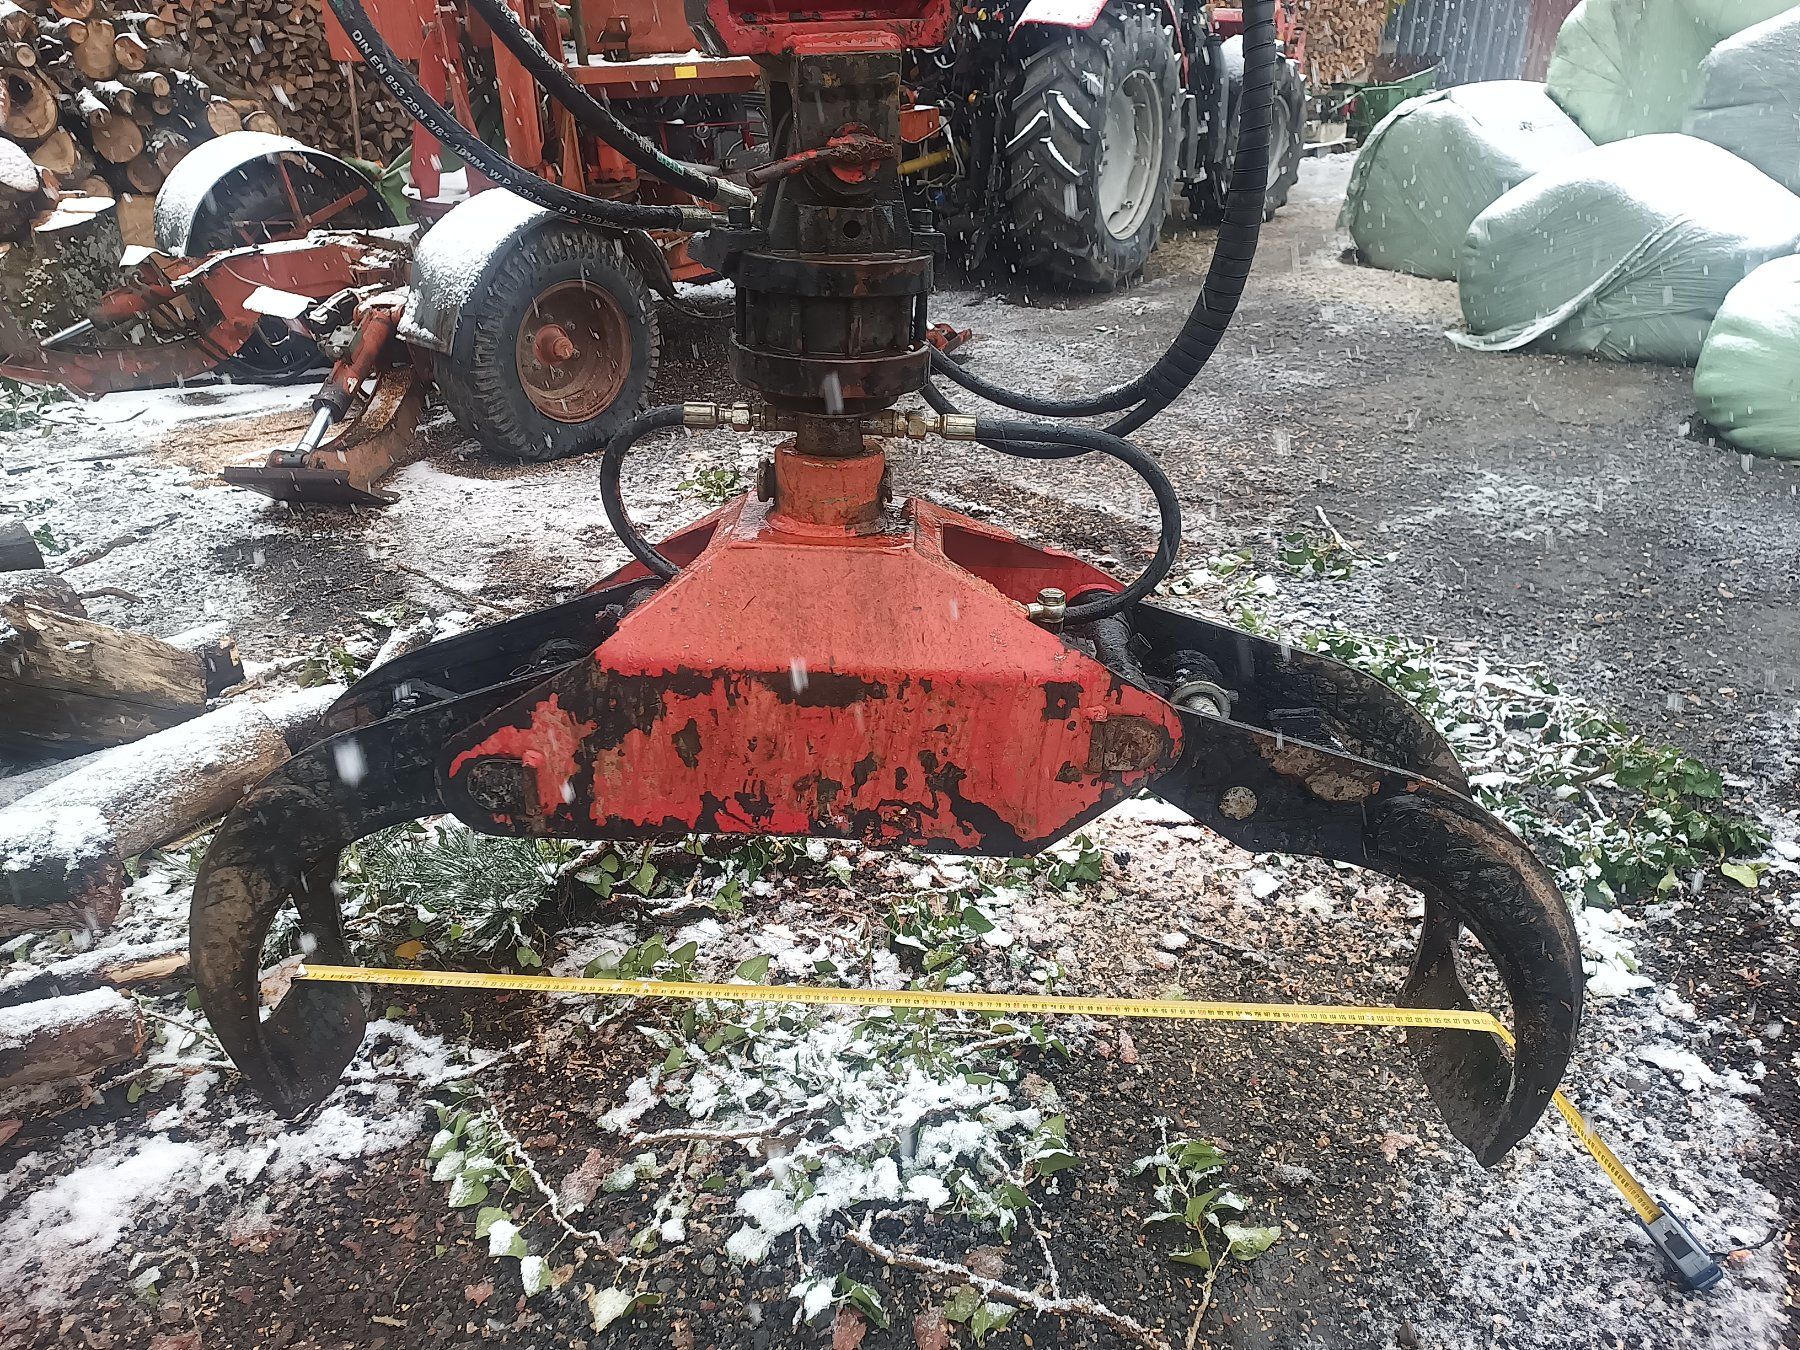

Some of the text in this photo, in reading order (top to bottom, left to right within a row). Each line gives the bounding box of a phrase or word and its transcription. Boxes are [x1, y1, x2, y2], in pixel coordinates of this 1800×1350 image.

[352, 29, 373, 55] DIN
[370, 55, 387, 75] EN
[385, 75, 405, 97] 853
[403, 96, 428, 120] 2SN
[515, 186, 534, 199] 330
